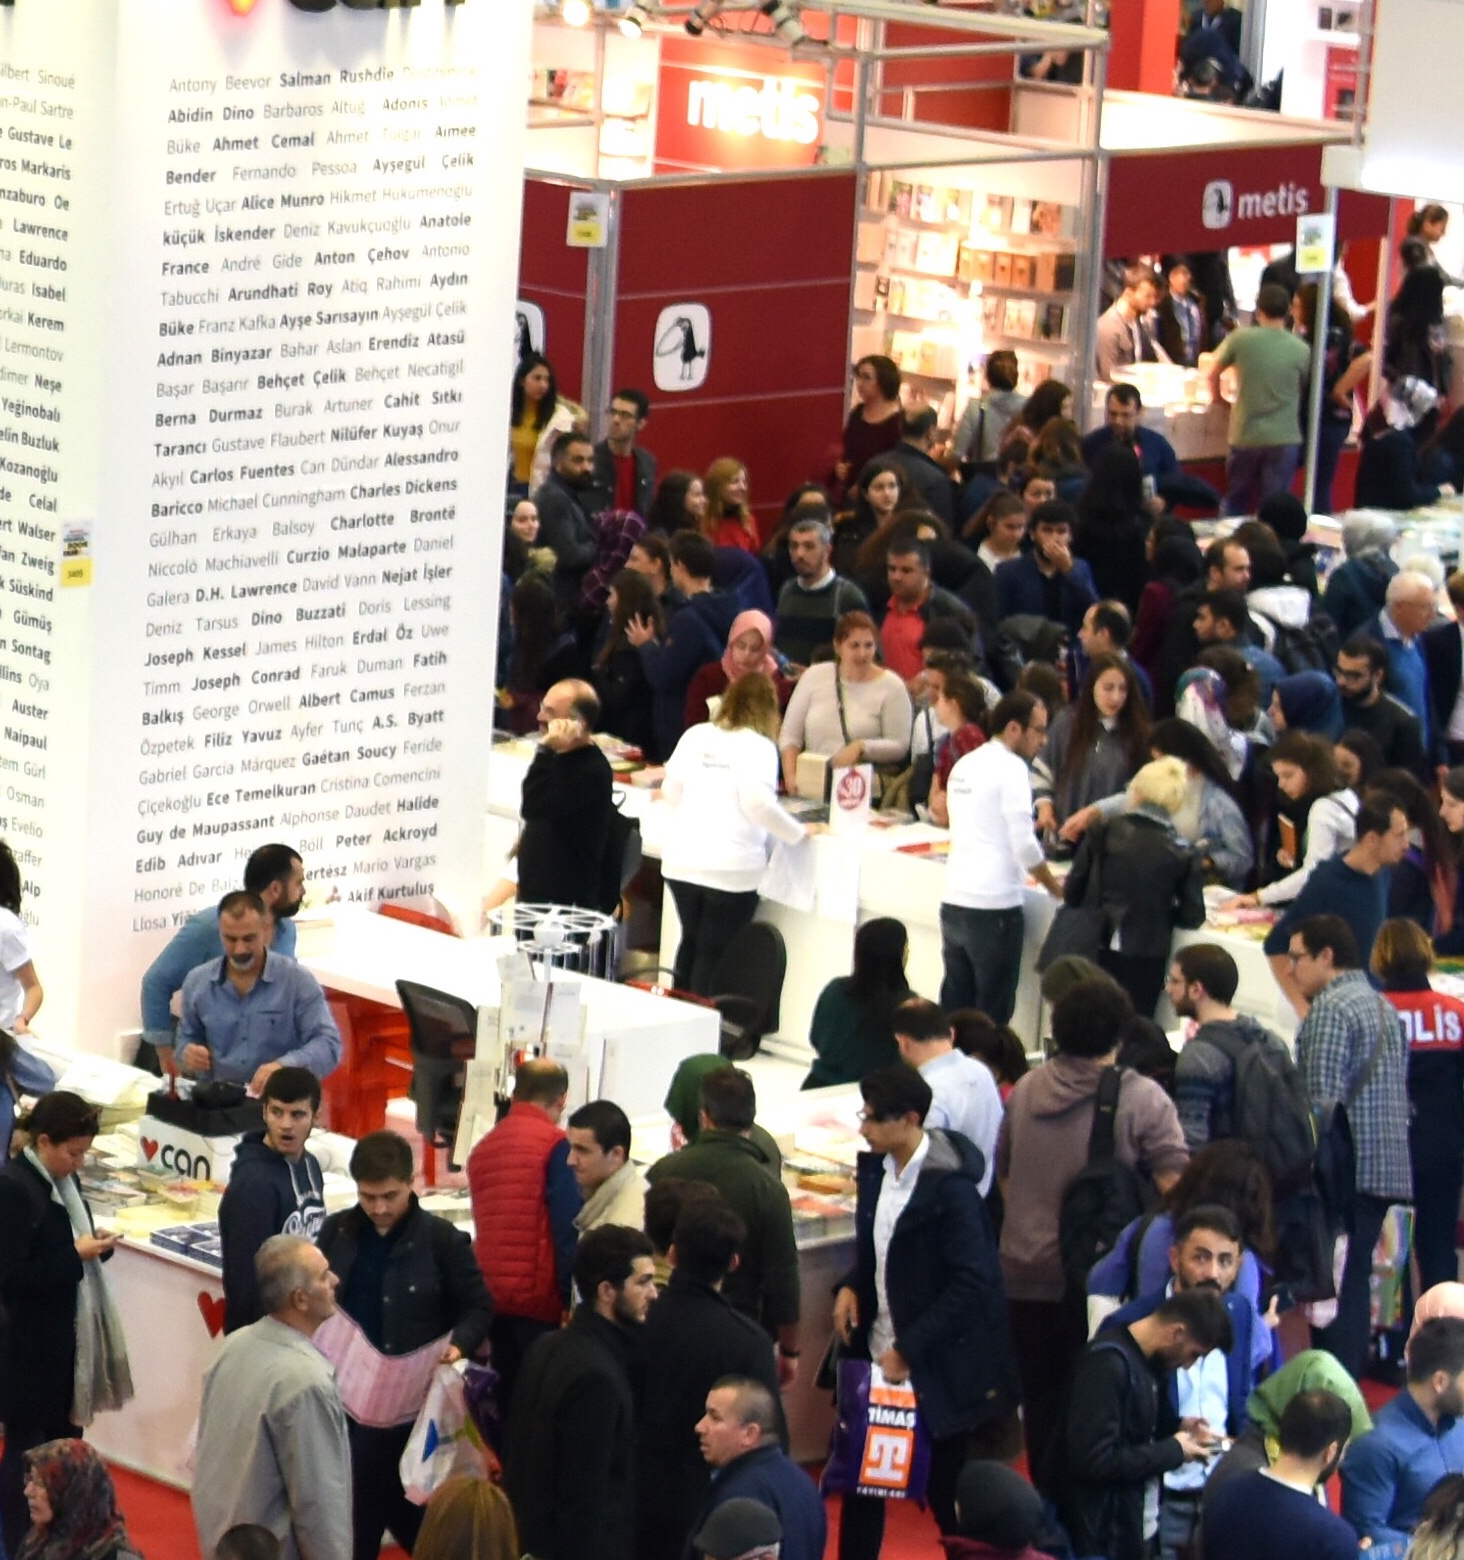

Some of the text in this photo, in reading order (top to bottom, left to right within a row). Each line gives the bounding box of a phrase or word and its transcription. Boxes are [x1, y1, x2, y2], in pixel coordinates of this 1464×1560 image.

[280, 71, 331, 87] Salman
[687, 77, 819, 144] metis
[241, 194, 324, 210] Alice Munro
[1238, 184, 1308, 219] metis
[314, 247, 409, 265] Anton Çehov
[228, 282, 332, 301] Arundhati Roy
[190, 464, 294, 484] Carlos Fuentes
[350, 479, 457, 499] Charles Dickens
[331, 505, 455, 530] Charlotte Brontë
[21, 552, 54, 576] Zweig
[9, 579, 53, 602] Süskind
[196, 582, 297, 602] D.H. Lawrence
[144, 642, 246, 666] Joseph Kessel
[192, 666, 300, 691] Joseph Conrad
[12, 699, 48, 720] Auster
[299, 688, 395, 708] Albert Camus
[137, 815, 274, 845] Guy de Maupassant
[336, 823, 437, 847] Peter Ackroyd
[161, 1144, 210, 1182] can
[869, 1407, 915, 1430] TİMAŞ
